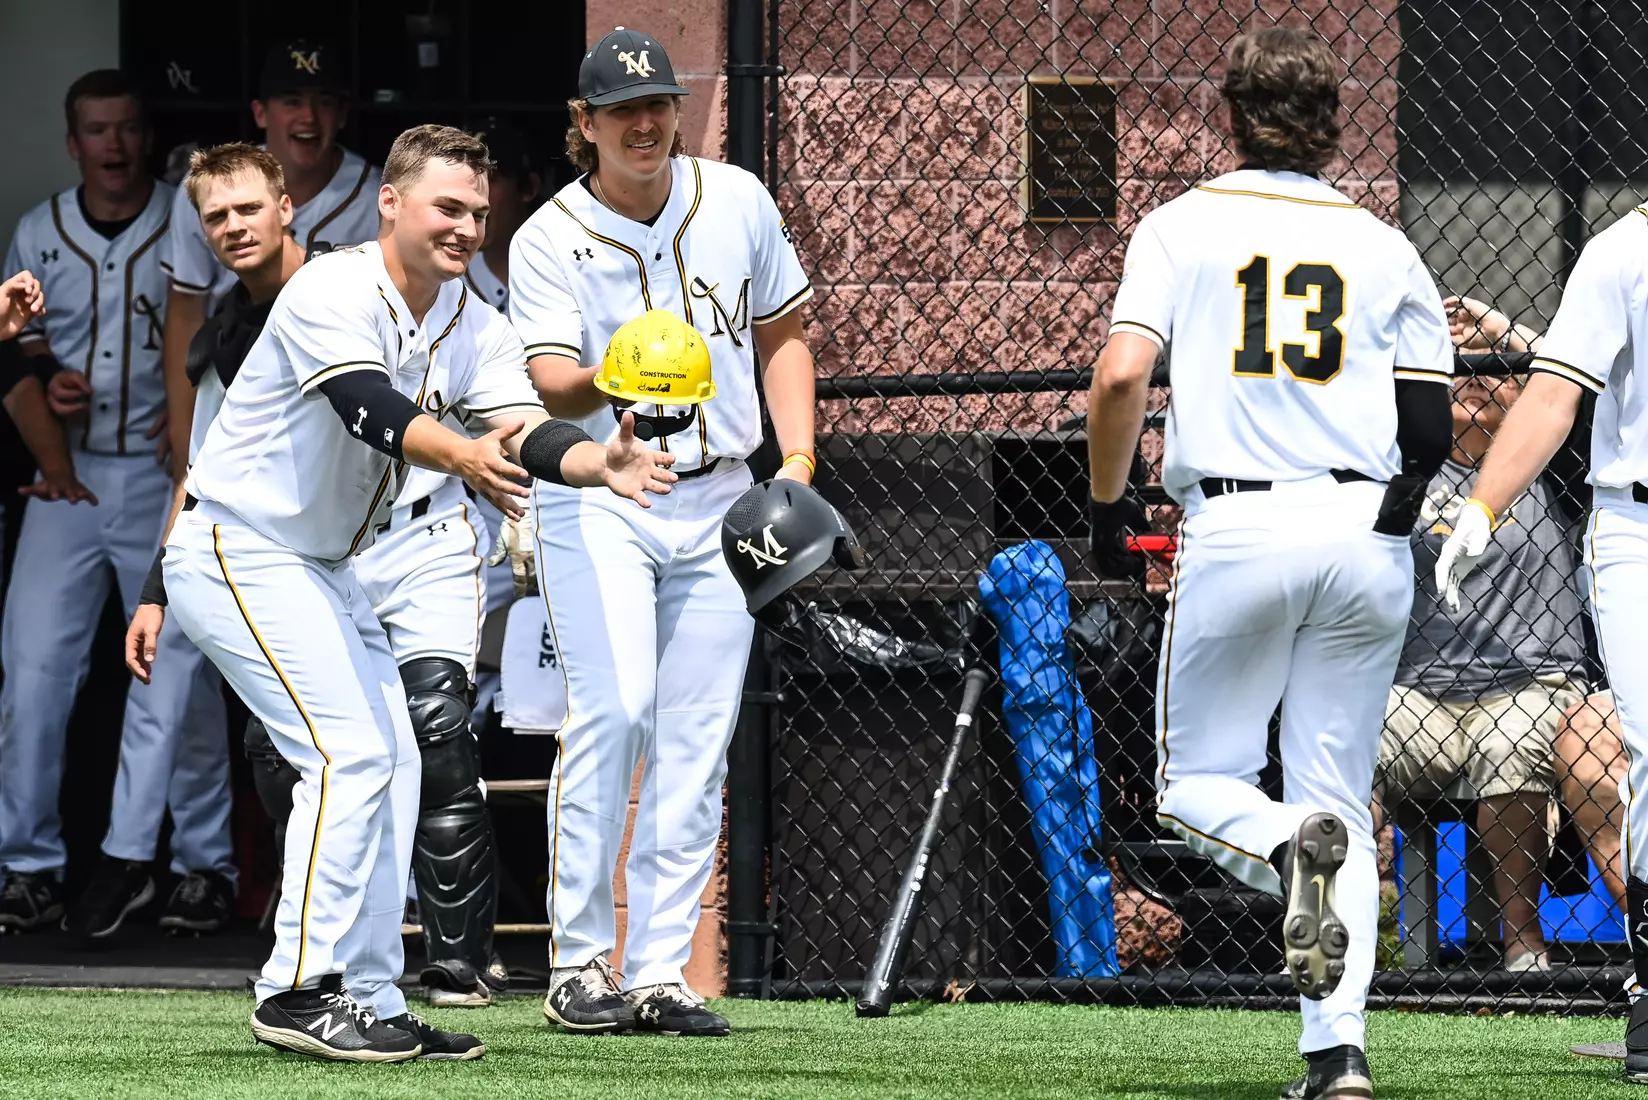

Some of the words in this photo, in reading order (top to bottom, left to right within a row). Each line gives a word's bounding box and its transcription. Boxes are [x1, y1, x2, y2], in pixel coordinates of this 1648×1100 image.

[617, 50, 656, 78] M
[1232, 253, 1347, 386] 13
[640, 370, 687, 379] CONSTRUCTION
[307, 1012, 348, 1041] N
